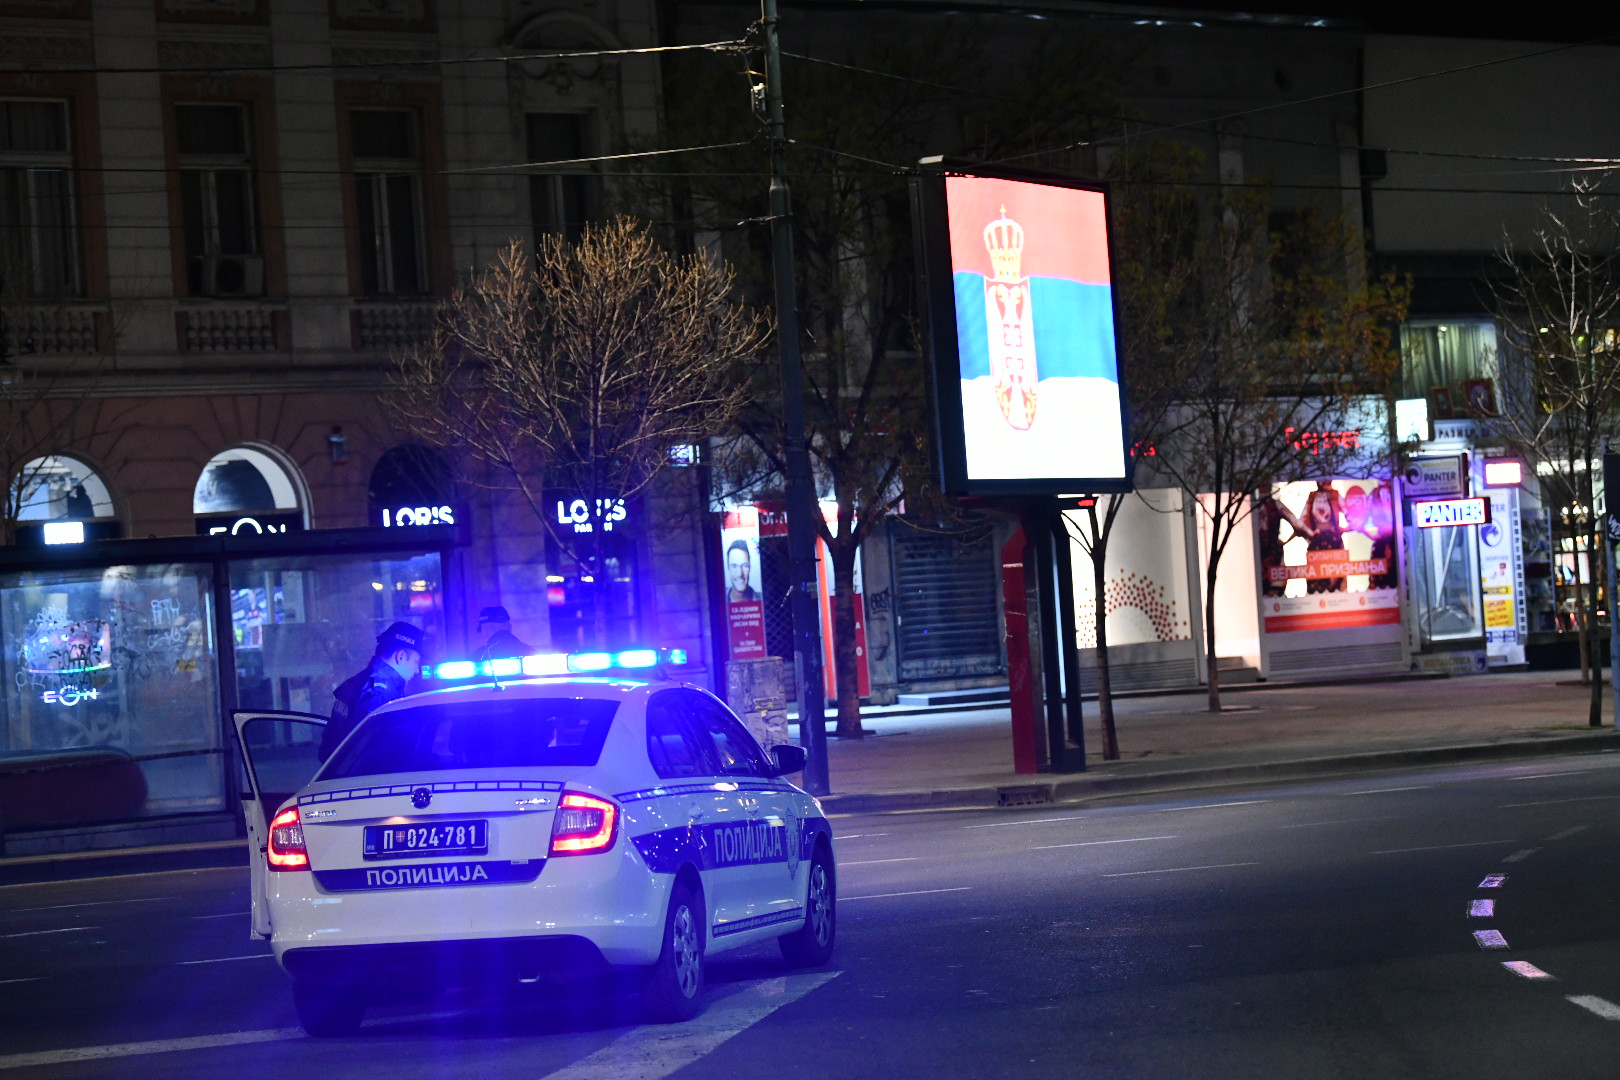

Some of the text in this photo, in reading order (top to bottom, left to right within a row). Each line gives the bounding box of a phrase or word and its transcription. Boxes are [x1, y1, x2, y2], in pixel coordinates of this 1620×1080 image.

[1423, 471, 1457, 482] PANTER
[1422, 502, 1483, 523] PANTER
[1270, 559, 1386, 580] ВЕЛИКА ПРИЗНАЊА
[43, 685, 97, 706] EON
[384, 825, 476, 849] П 024-781
[714, 824, 783, 862] ПОЛИЦИЈА
[366, 864, 489, 886] ПОЛИЦИЈА
